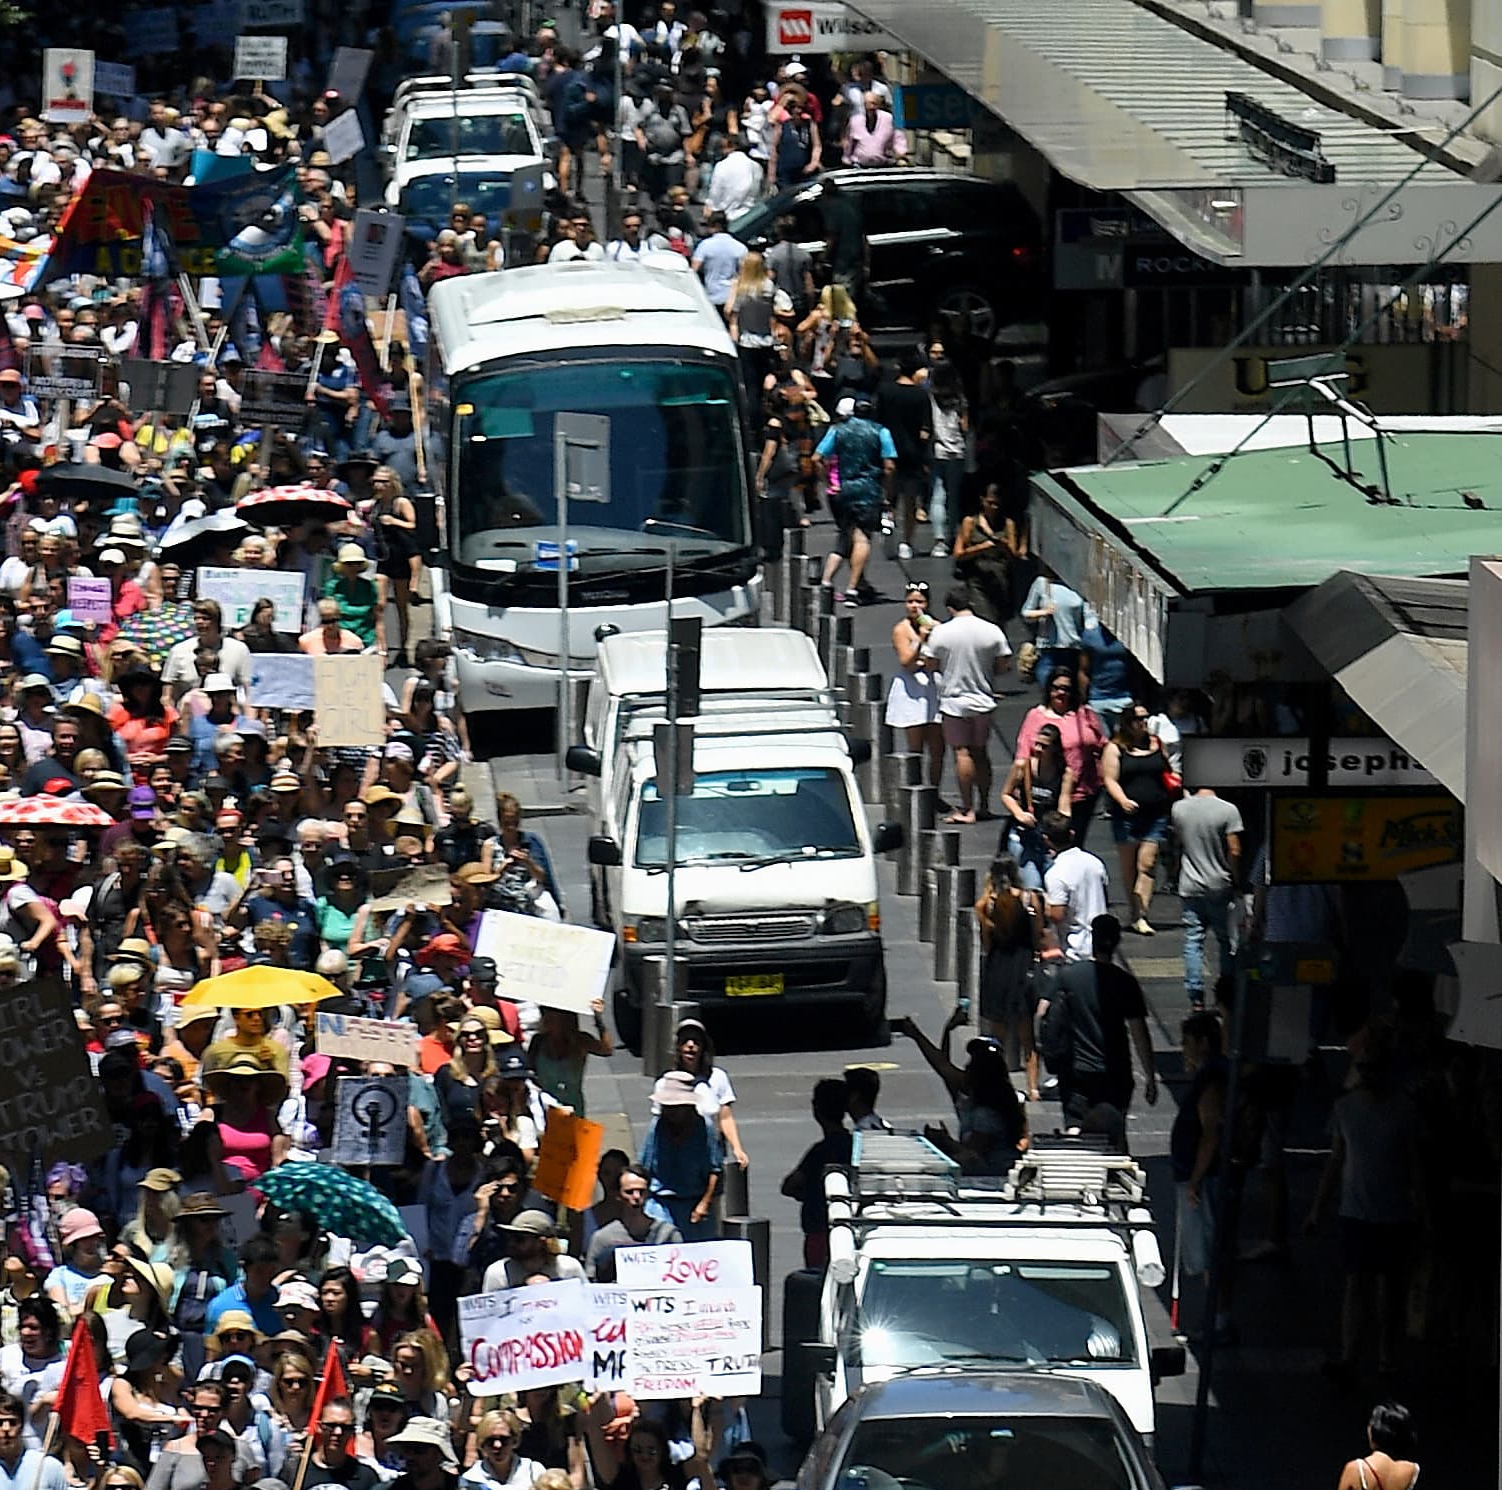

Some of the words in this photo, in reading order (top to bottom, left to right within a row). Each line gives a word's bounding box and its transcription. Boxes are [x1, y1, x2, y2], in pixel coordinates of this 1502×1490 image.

[1234, 357, 1368, 396] UG
[632, 1296, 674, 1314] WITS
[471, 1329, 583, 1383] COMPASSION
